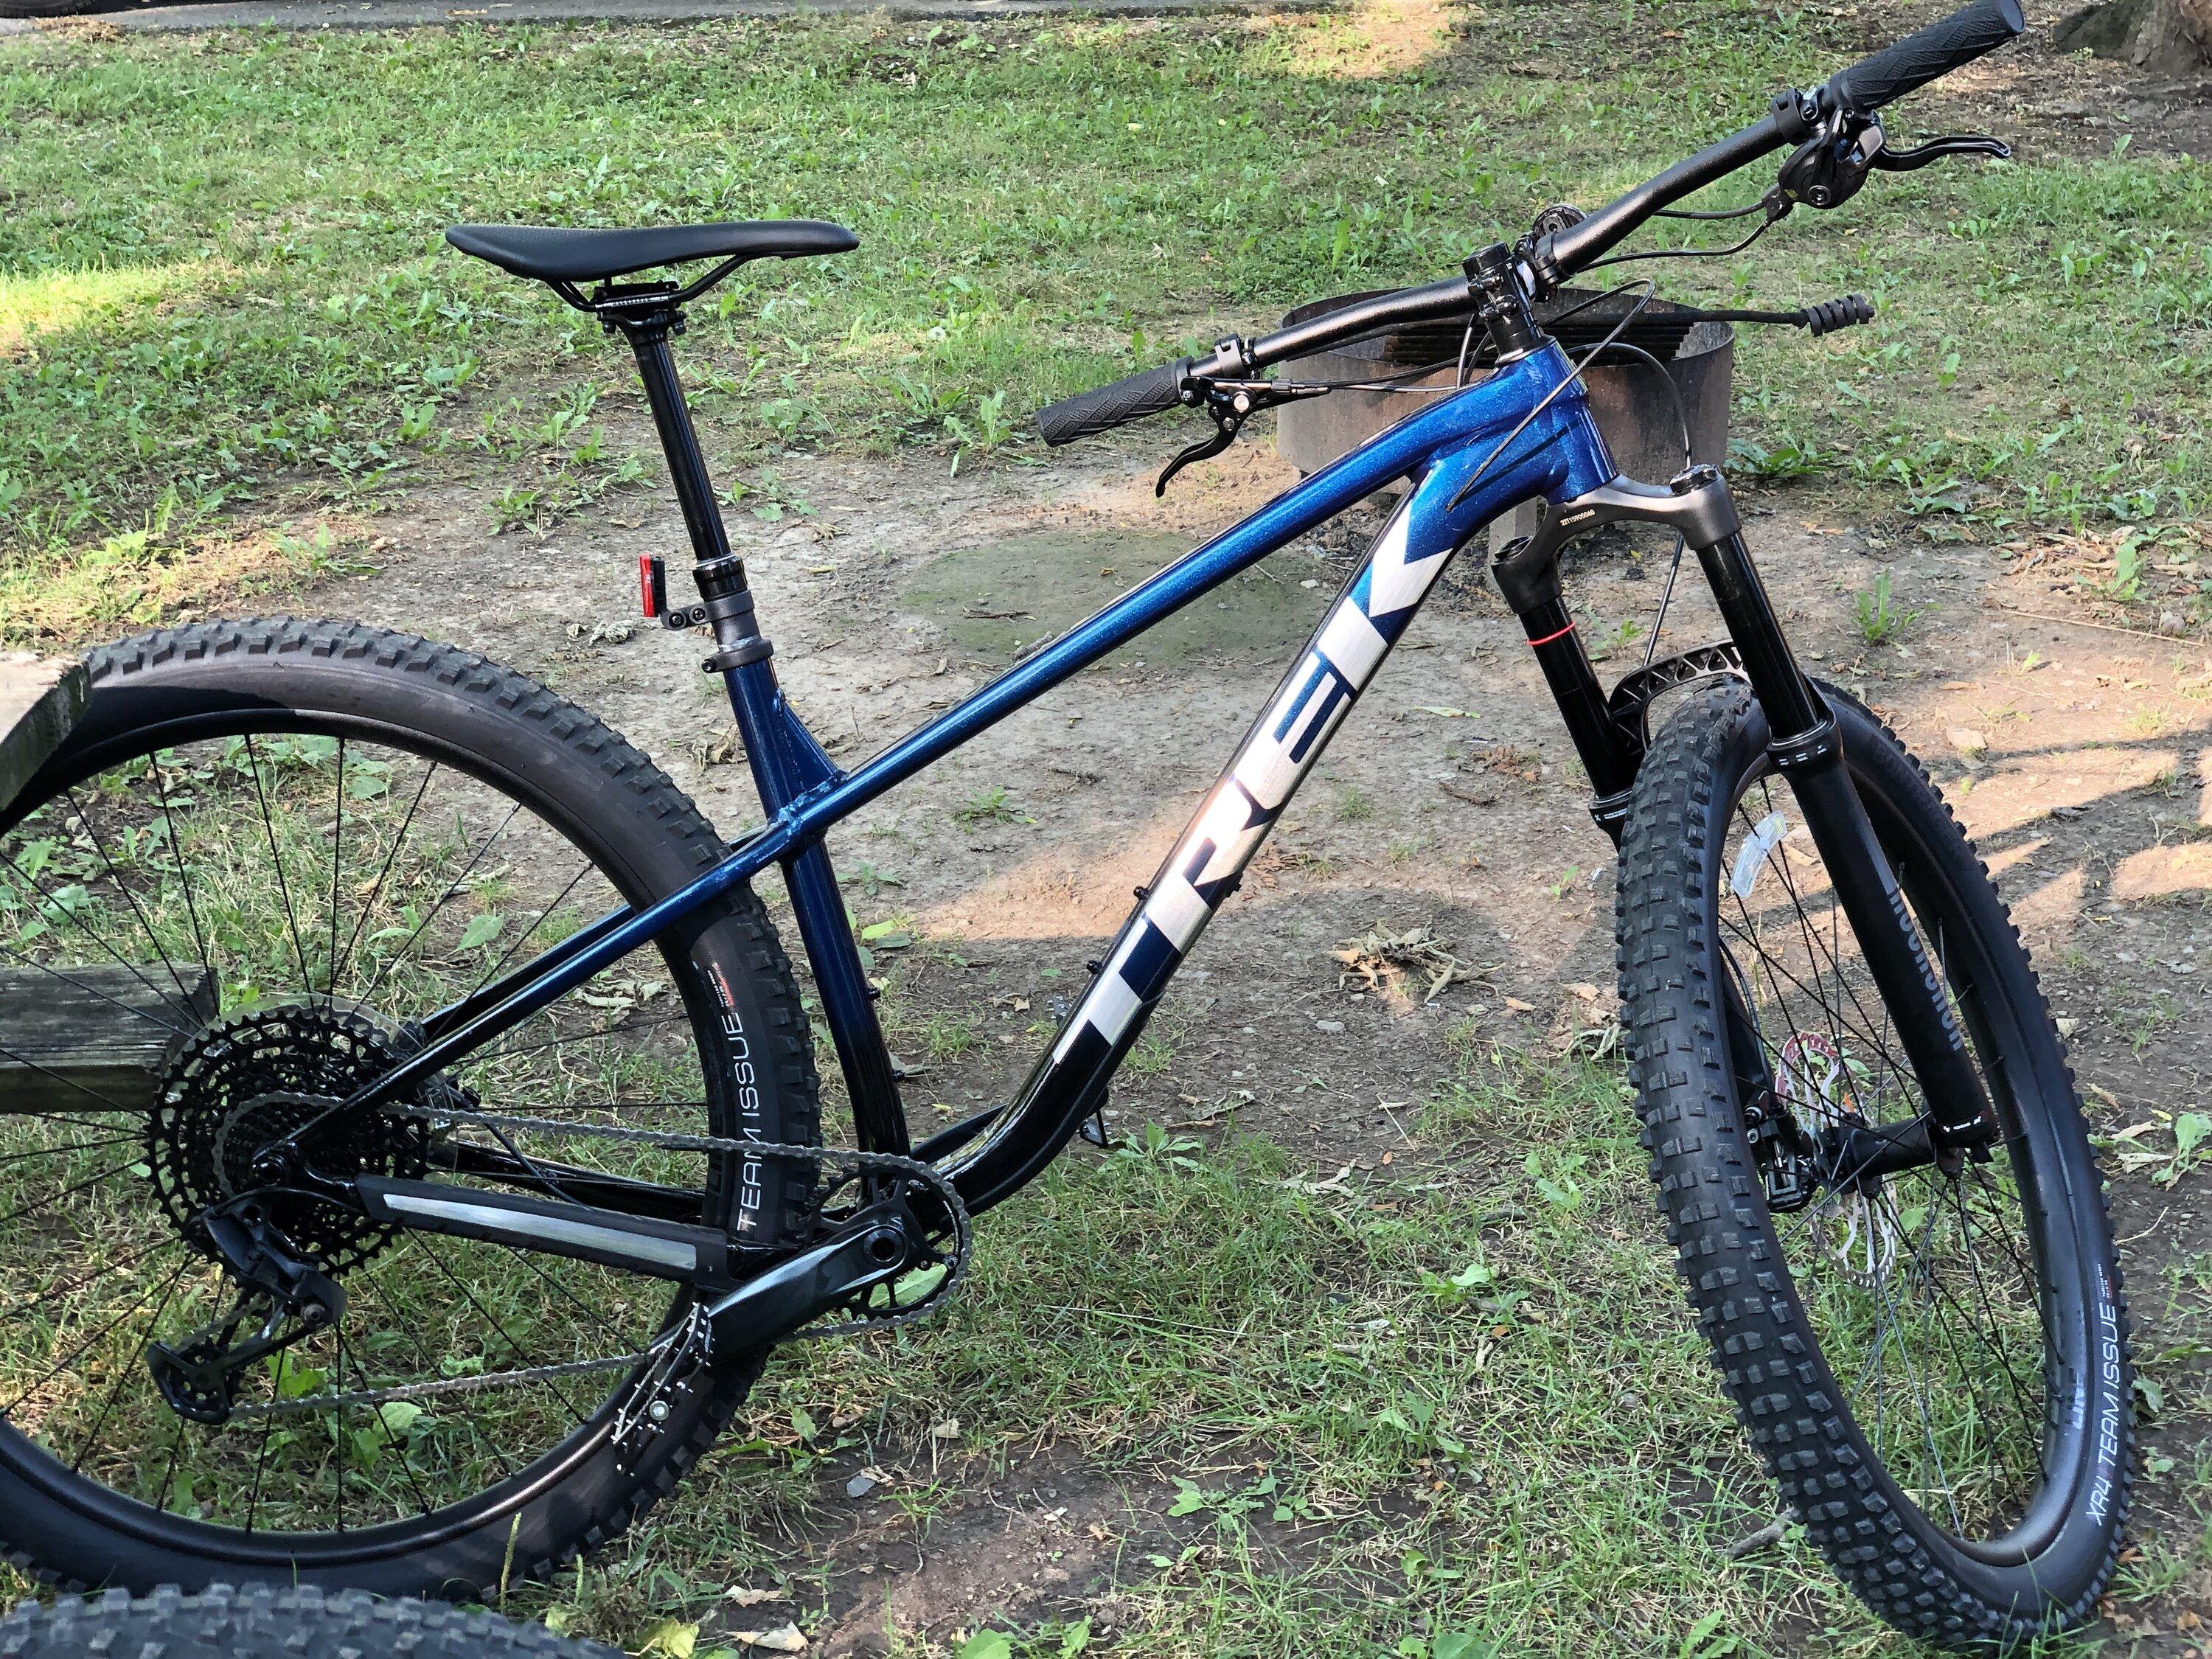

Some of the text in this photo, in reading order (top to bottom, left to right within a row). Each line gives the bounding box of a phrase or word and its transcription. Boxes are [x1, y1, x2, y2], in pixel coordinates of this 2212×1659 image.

[1052, 495, 1454, 1065] TREK
[720, 1012, 760, 1116] ISSUE
[737, 1127, 762, 1231] TEAM
[2098, 1301, 2121, 1390] ISSUE
[2098, 1391, 2121, 1467] TEAM
[2085, 1475, 2112, 1526] XR4
